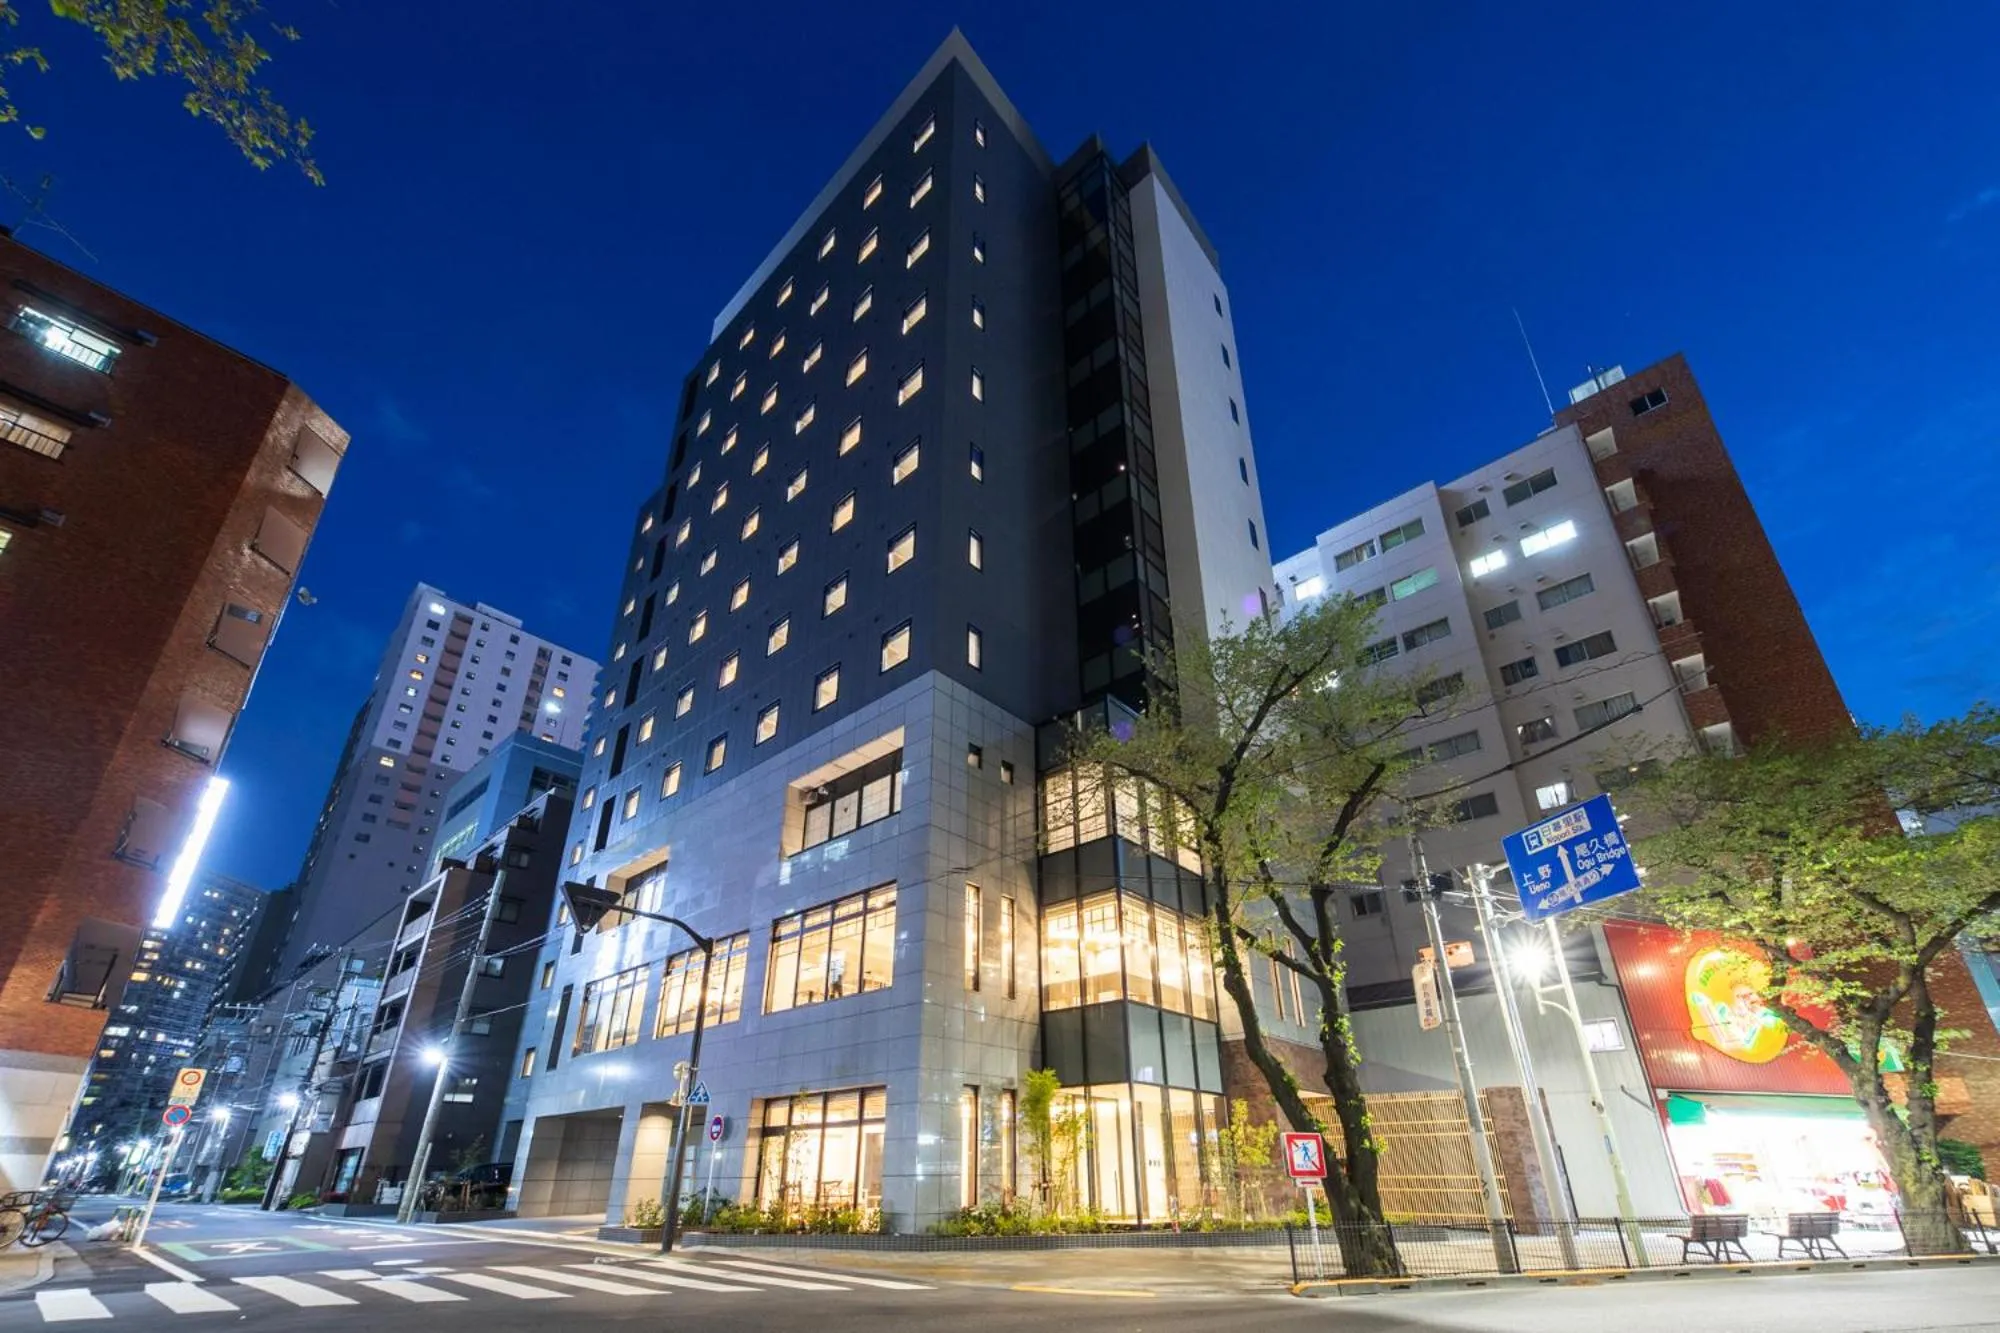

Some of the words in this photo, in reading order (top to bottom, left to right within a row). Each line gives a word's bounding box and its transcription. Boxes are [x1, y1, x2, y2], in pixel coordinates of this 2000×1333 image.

[1577, 856, 1595, 871] Ogu
[1595, 844, 1626, 863] Bridge
[1521, 863, 1553, 887] 上野
[1528, 880, 1551, 894] Ueno
